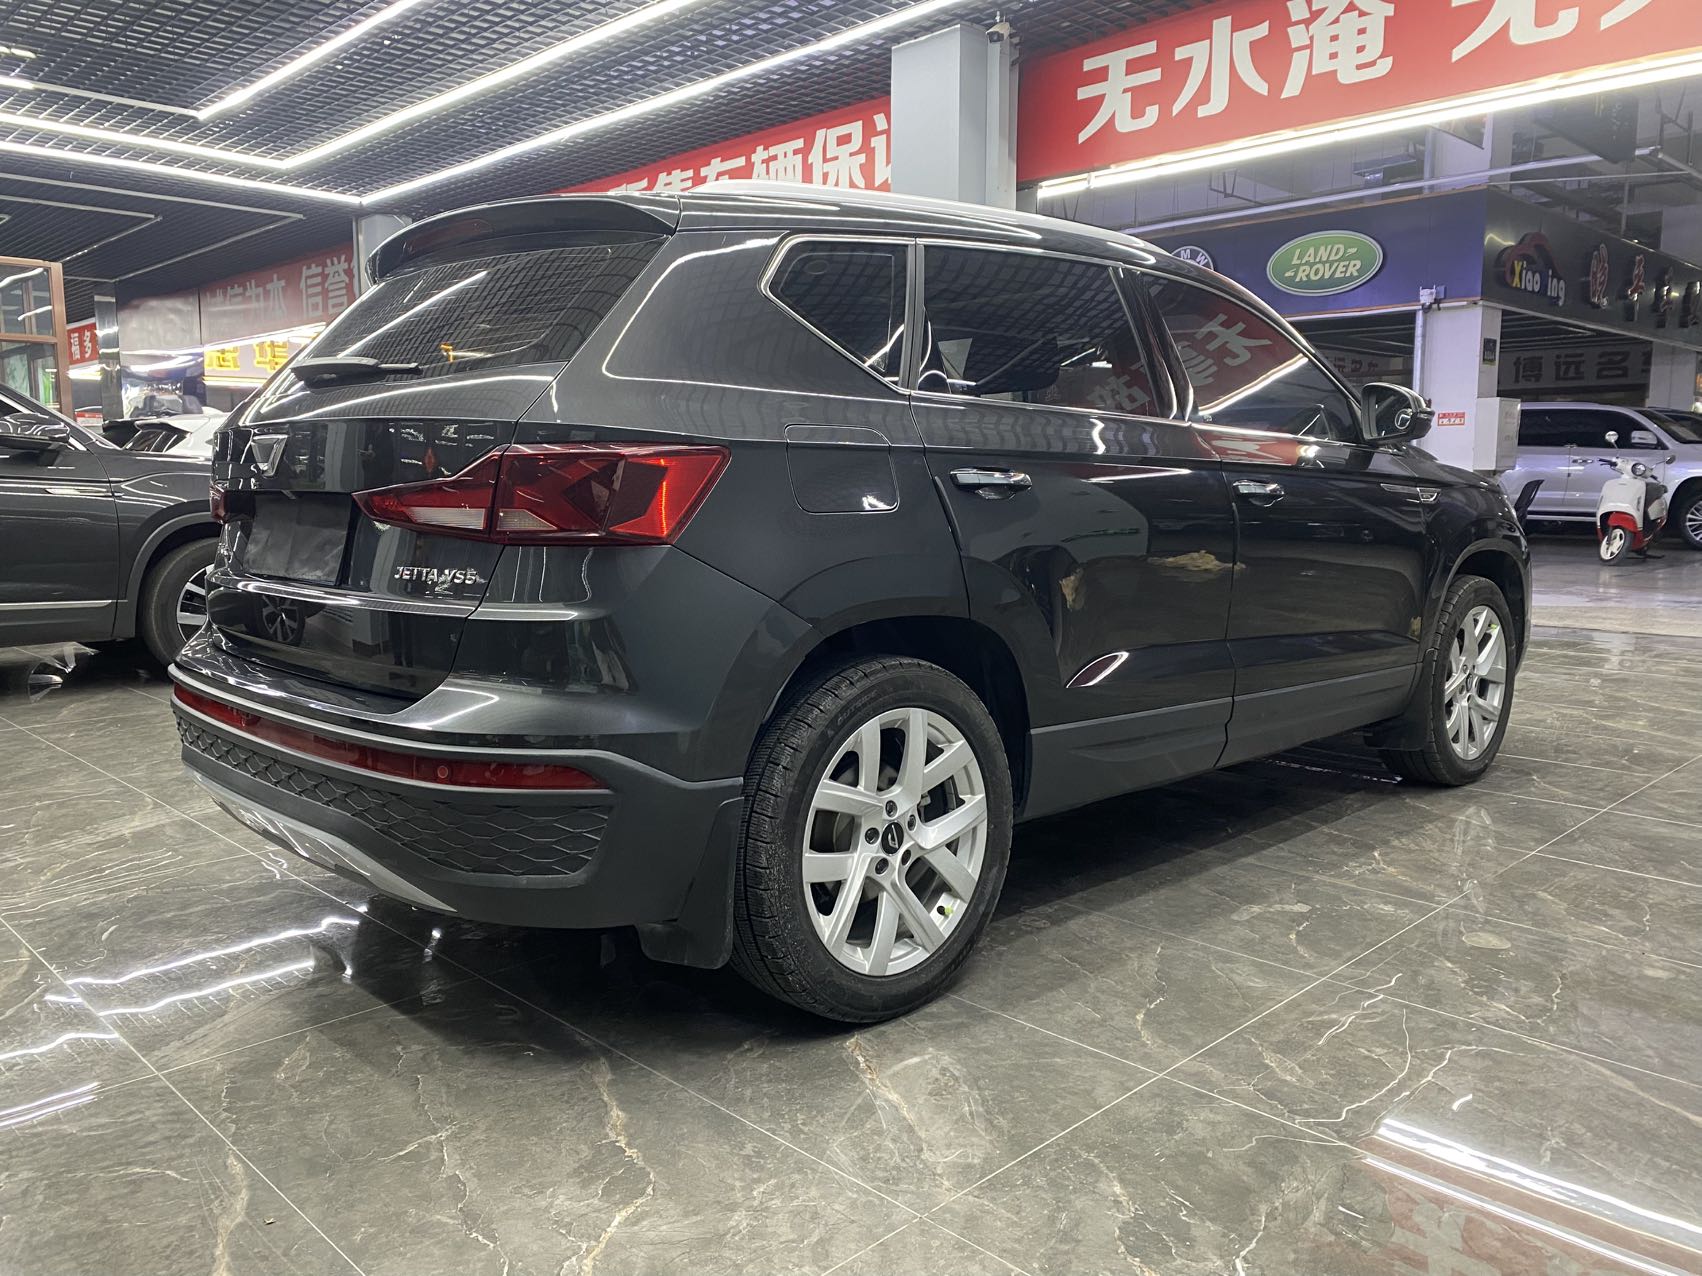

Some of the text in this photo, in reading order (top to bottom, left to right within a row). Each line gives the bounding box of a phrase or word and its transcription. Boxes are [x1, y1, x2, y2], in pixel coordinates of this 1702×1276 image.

[1077, 0, 1395, 144] 无水淹
[1291, 243, 1343, 265] LAND
[1295, 259, 1362, 282] ROVER
[300, 254, 356, 318] 信誉
[1513, 351, 1649, 384] 博远名
[394, 566, 477, 585] JETTA VS5
